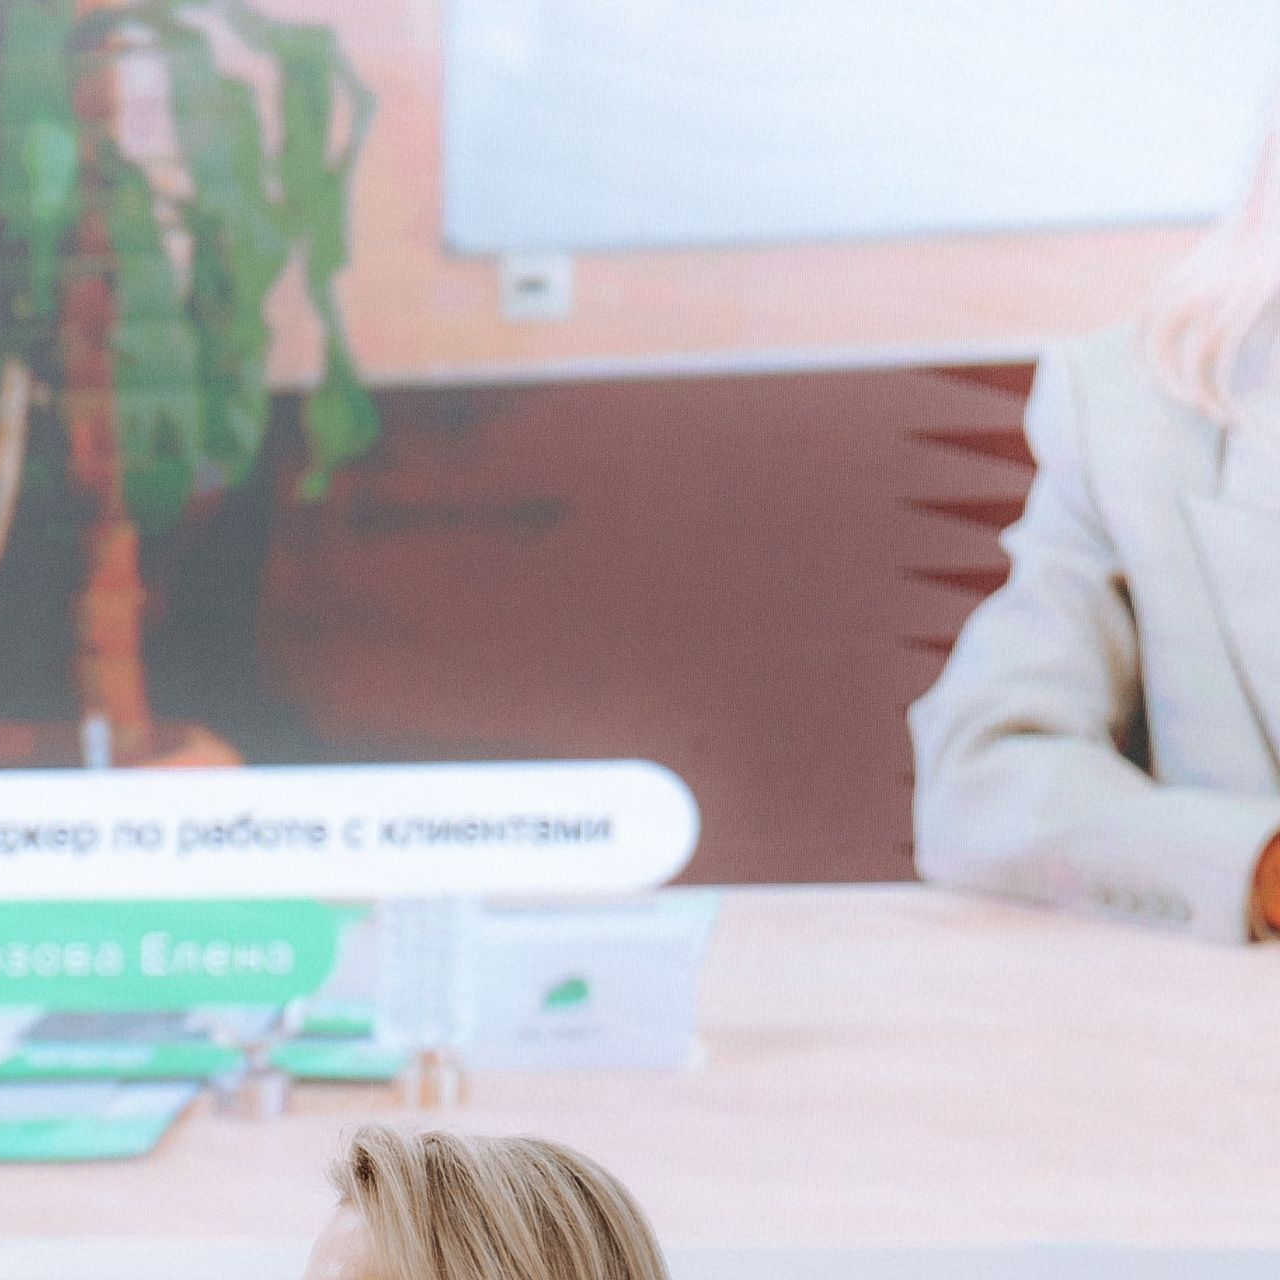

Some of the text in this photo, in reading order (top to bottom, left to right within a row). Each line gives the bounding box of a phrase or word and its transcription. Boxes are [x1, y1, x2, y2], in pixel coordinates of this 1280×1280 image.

[113, 820, 162, 851] по
[178, 814, 327, 855] работе
[342, 818, 363, 847] с
[381, 815, 613, 849] клиентами
[141, 932, 295, 977] Елена
